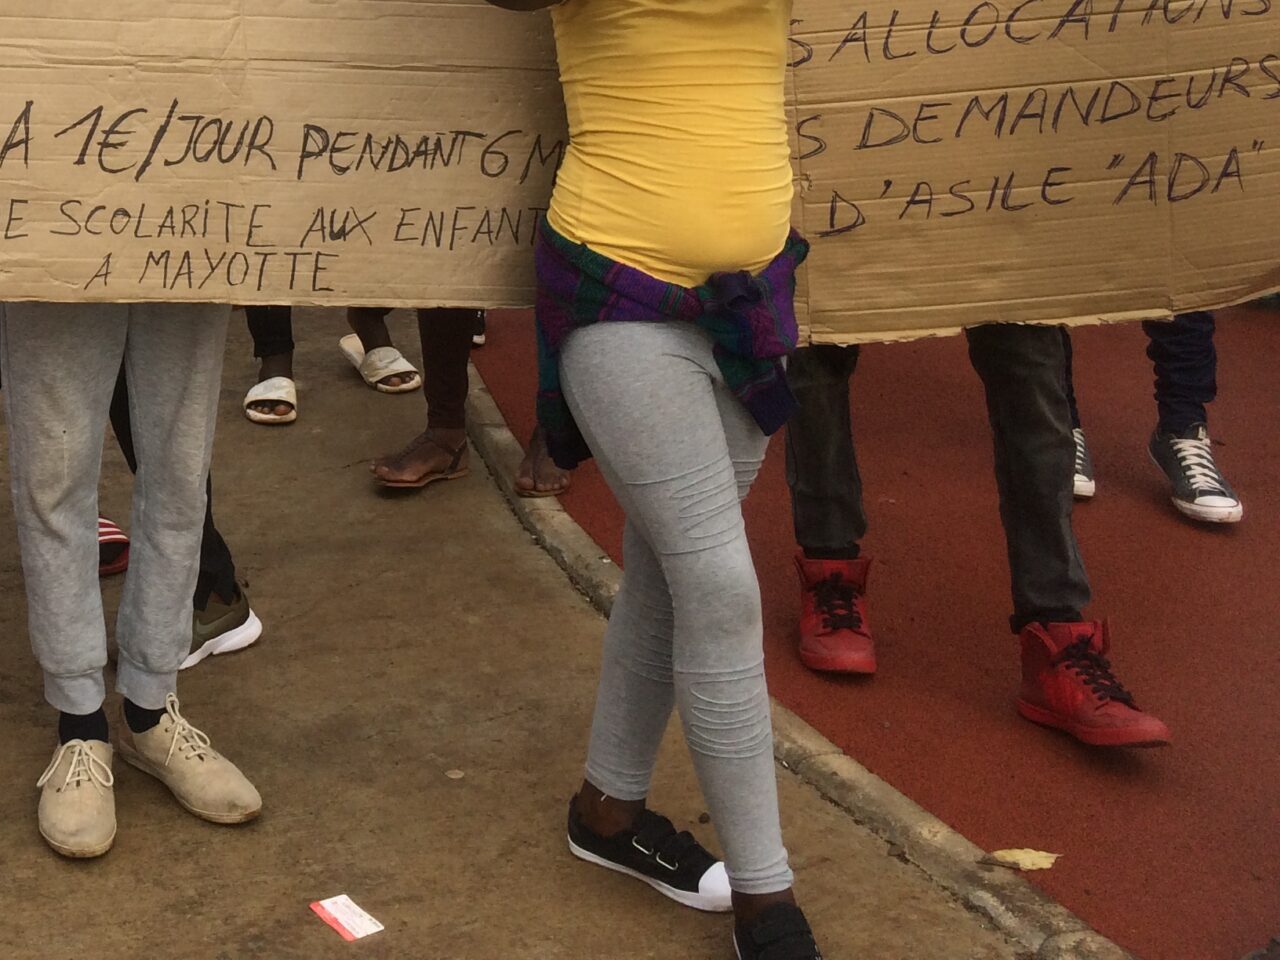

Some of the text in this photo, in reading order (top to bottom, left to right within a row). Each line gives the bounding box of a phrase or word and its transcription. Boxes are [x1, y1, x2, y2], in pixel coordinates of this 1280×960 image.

[853, 52, 1280, 151] DEMANDEURS
[53, 97, 277, 183] 1€/JOUR
[296, 129, 489, 181] PENDANT
[480, 129, 523, 178] 6
[48, 198, 276, 249] SCOLARITE
[300, 204, 376, 249] AUX
[814, 164, 1076, 239] D'ASILE
[83, 247, 341, 293] A MAYOTTE
